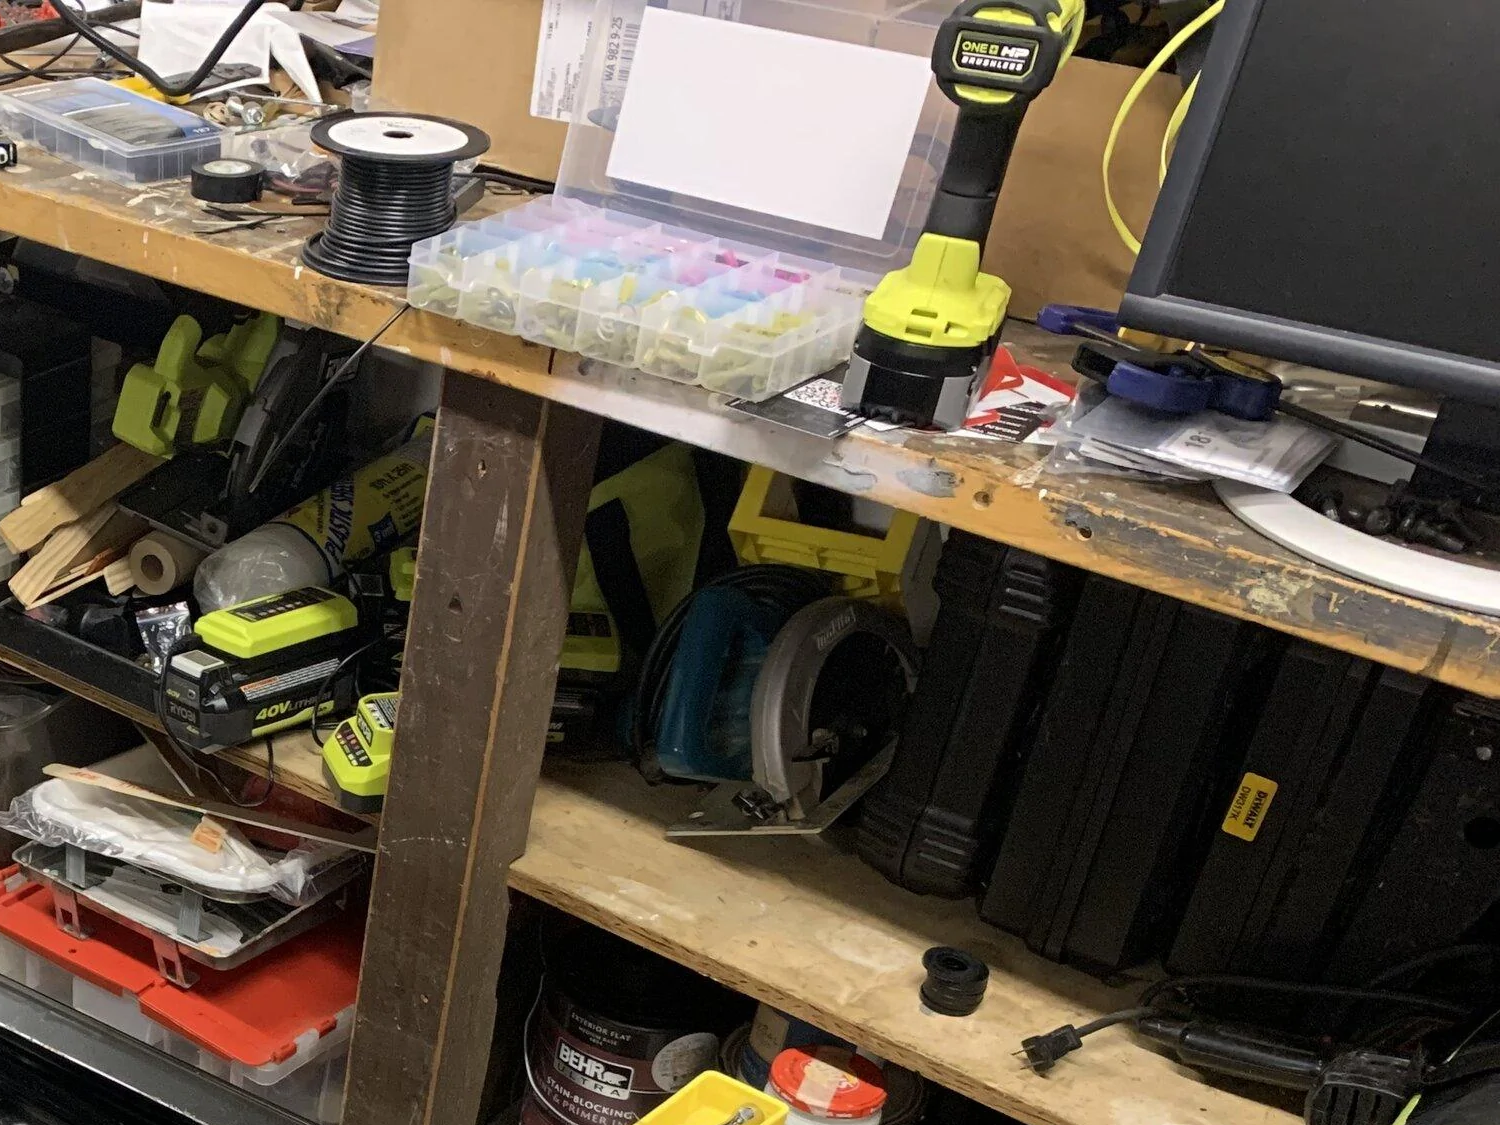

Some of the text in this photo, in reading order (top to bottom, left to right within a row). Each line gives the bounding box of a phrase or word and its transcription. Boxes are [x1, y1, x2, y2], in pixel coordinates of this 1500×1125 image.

[605, 17, 623, 81] WA 982 9-25
[961, 56, 1024, 72] BRUSHLESS
[1001, 46, 1030, 58] HP
[255, 702, 291, 720] 40V
[557, 1062, 621, 1097] ULTRA
[559, 1043, 605, 1082] BEHR
[546, 1076, 634, 1120] STAIN-BLOCKING
